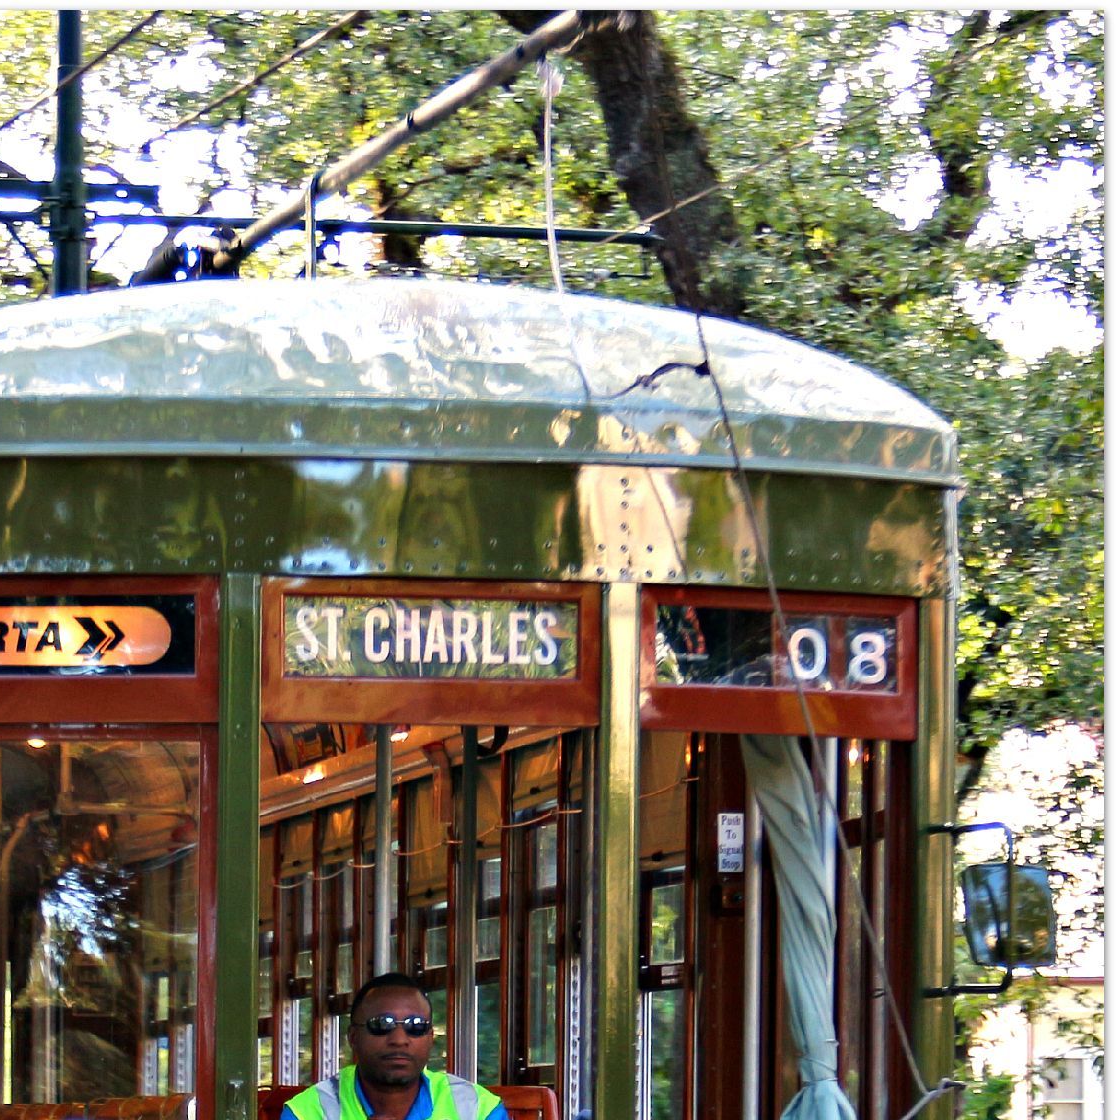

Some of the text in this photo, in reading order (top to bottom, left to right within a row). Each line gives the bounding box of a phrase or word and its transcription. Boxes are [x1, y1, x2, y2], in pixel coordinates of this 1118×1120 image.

[294, 607, 558, 667] ST. CHARLES
[721, 815, 741, 826] Push
[725, 829, 737, 840] To
[721, 859, 741, 871] Stop
